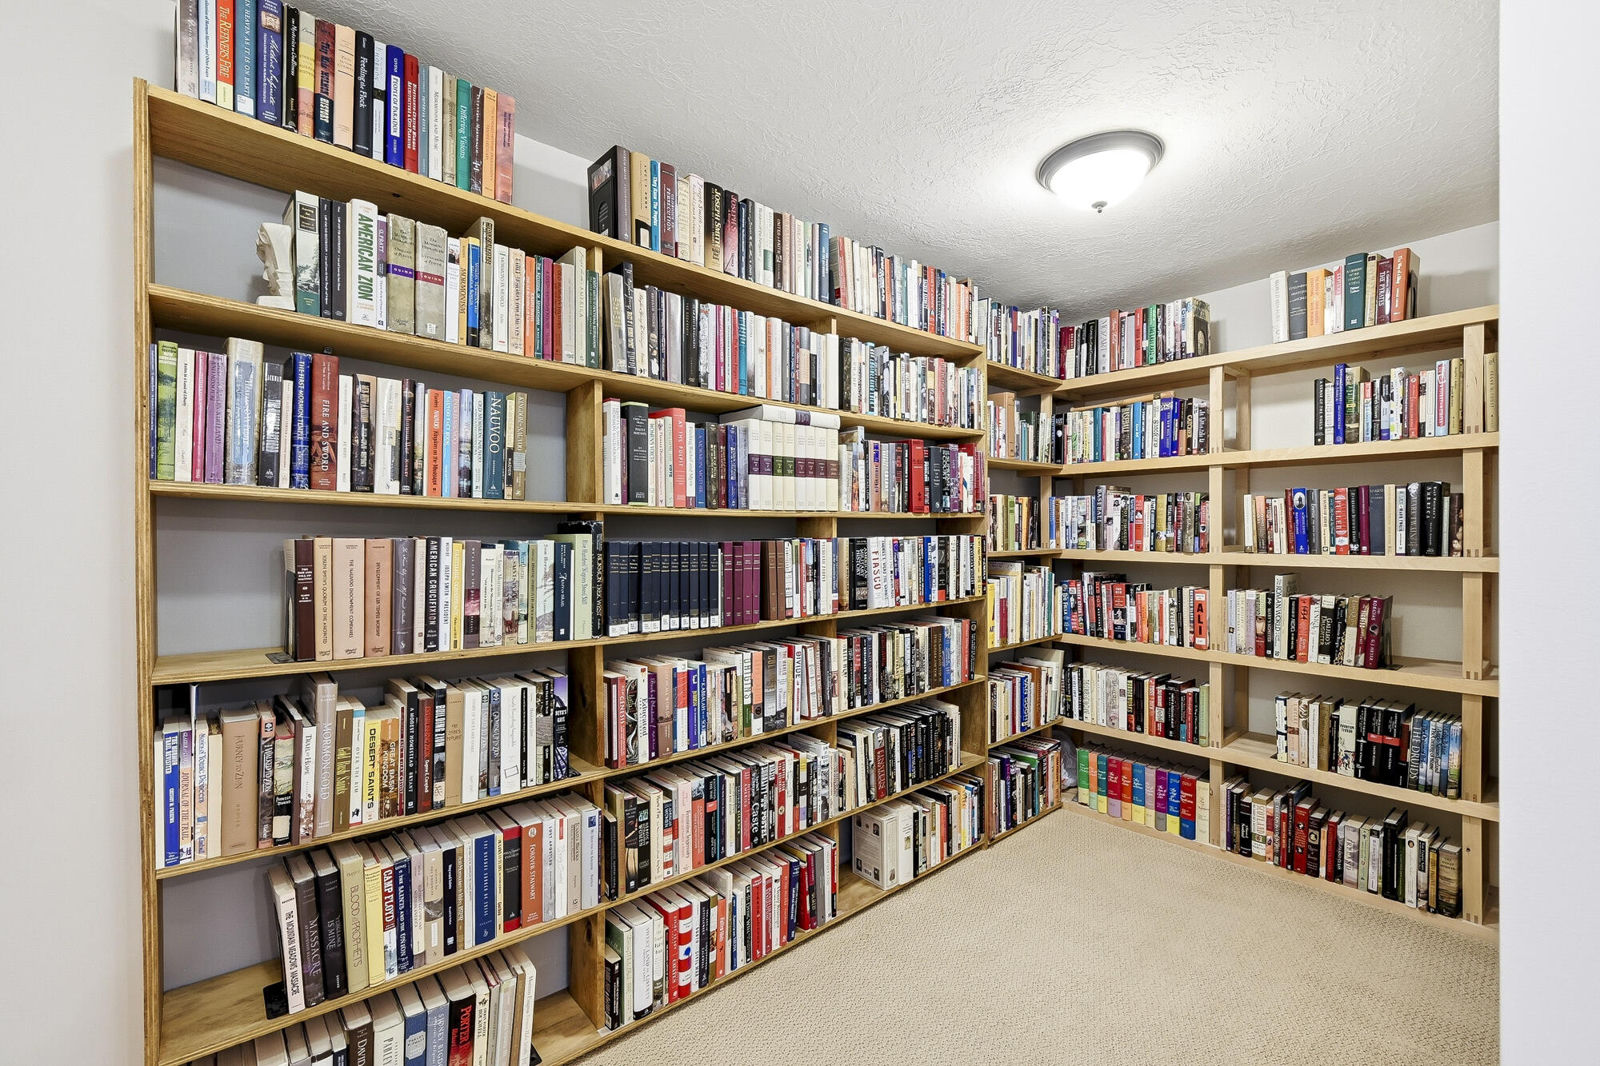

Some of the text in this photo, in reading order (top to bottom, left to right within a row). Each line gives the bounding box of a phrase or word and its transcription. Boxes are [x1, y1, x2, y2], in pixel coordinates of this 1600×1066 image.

[244, 37, 250, 45] AS
[244, 47, 250, 57] IT
[219, 61, 231, 78] FIRE
[244, 65, 250, 75] ON
[358, 56, 367, 81] Feeding
[266, 70, 279, 106] Infinite
[360, 90, 368, 109] Flock
[320, 97, 330, 123] HISTORY
[458, 105, 467, 159] Differing Visions
[358, 213, 373, 301] AMERICAN ZION
[1099, 319, 1108, 352] MOZART
[322, 399, 330, 418] FIRE
[489, 397, 502, 454] NAUVOO
[678, 420, 684, 430] AT
[321, 441, 330, 471] SWORD
[429, 540, 437, 625] AMERICAN CRUCIFIXION
[872, 551, 881, 590] FIASCO
[1196, 603, 1204, 635] ALI
[435, 704, 445, 748] BUILDING ZION
[198, 754, 207, 774] Young
[234, 735, 245, 763] JOURNEY
[320, 722, 332, 800] MORMON GOLD
[338, 747, 351, 759] Gold
[1410, 726, 1421, 780] THE DRUIDS
[234, 772, 244, 789] ZION
[367, 728, 376, 809] DESERT SAINTS
[198, 775, 206, 803] Pioneers
[336, 777, 350, 795] Saints
[182, 800, 189, 808] OF
[751, 802, 759, 833] Caste
[181, 823, 189, 840] TRAIL
[1256, 805, 1265, 834] SCOTLAND
[383, 869, 394, 922] CAMP FLOYD
[327, 920, 335, 950] IS MINE
[350, 885, 362, 968] BLOOD PROPHETS
[285, 910, 299, 996] THE MOUNTAIN MEADOWS MASSACRE
[309, 918, 321, 976] MASSACRE
[459, 1005, 472, 1043] PORTER
